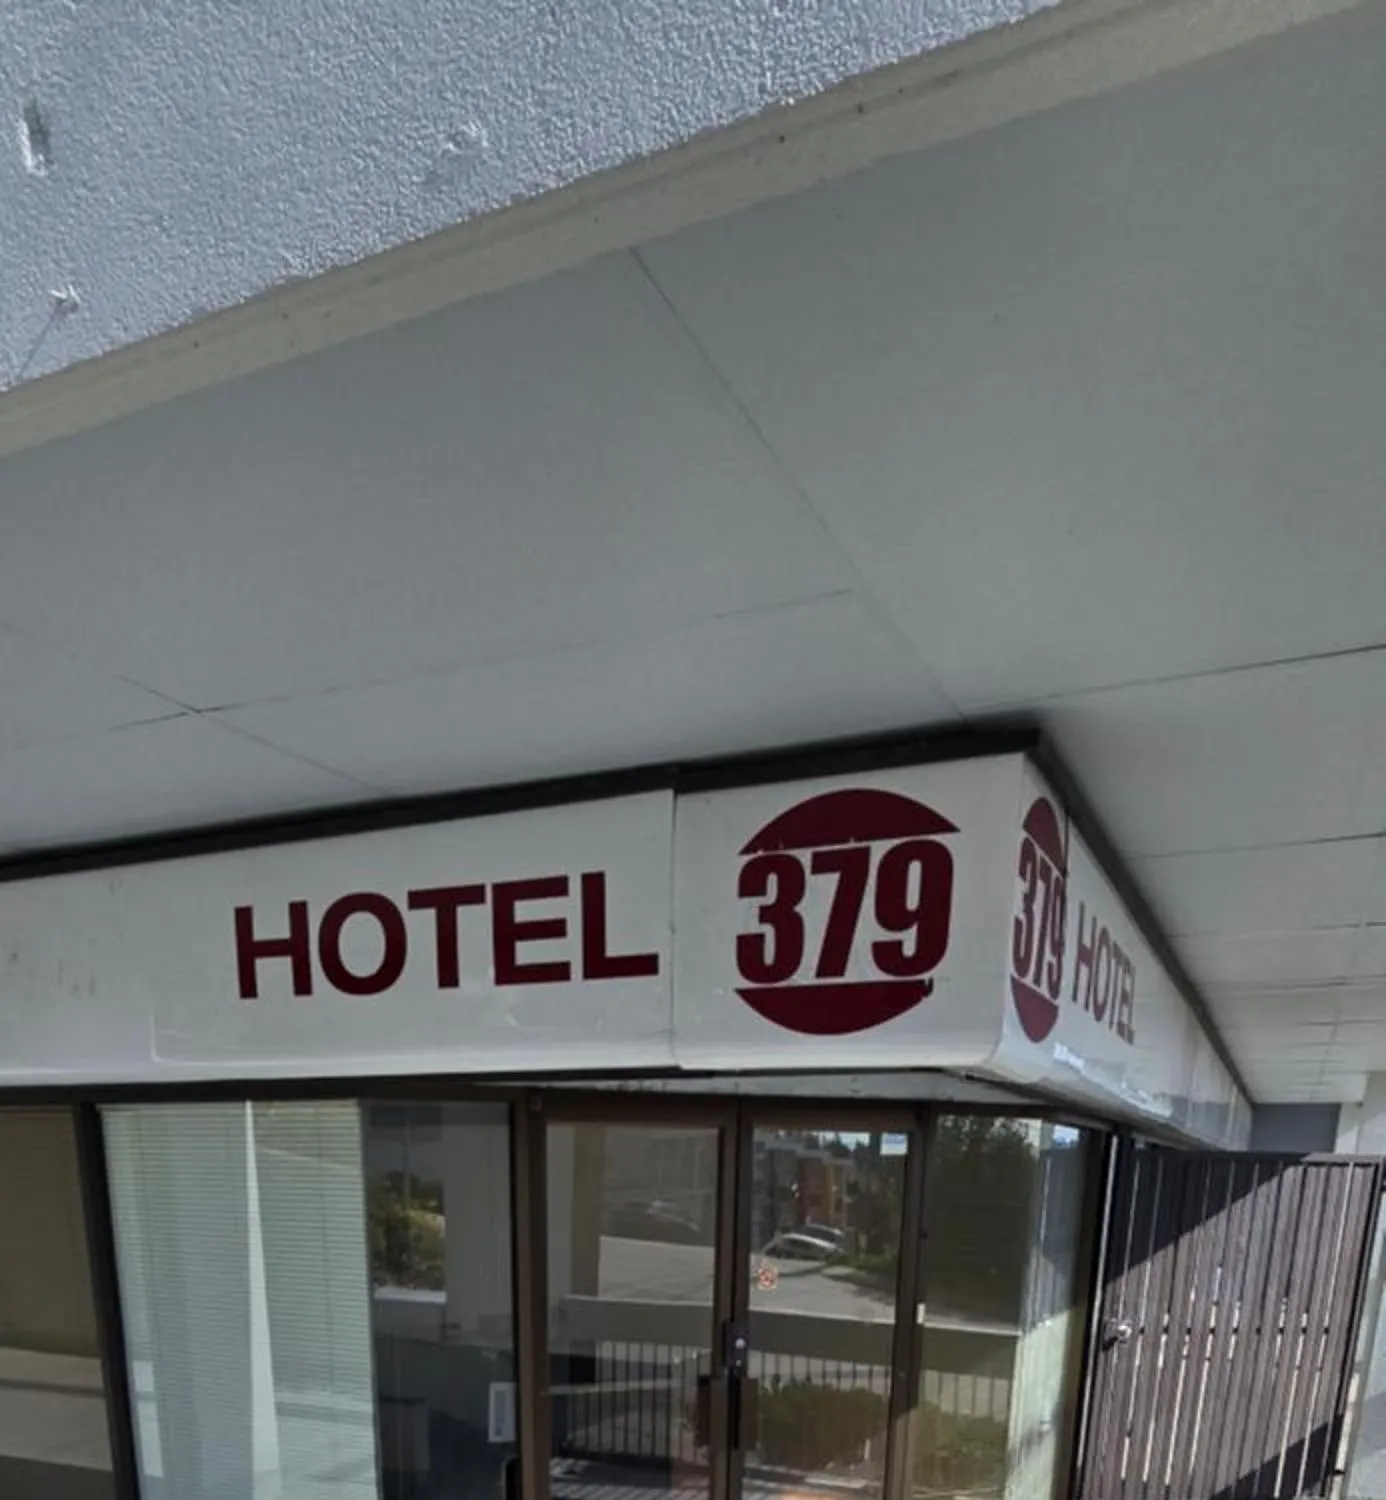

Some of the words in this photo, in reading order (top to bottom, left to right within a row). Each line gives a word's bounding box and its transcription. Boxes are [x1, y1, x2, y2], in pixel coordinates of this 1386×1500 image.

[234, 871, 659, 999] HOTEL
[736, 839, 954, 984] 379
[1012, 836, 1065, 1000] 379
[1072, 901, 1136, 1045] HOTEL
